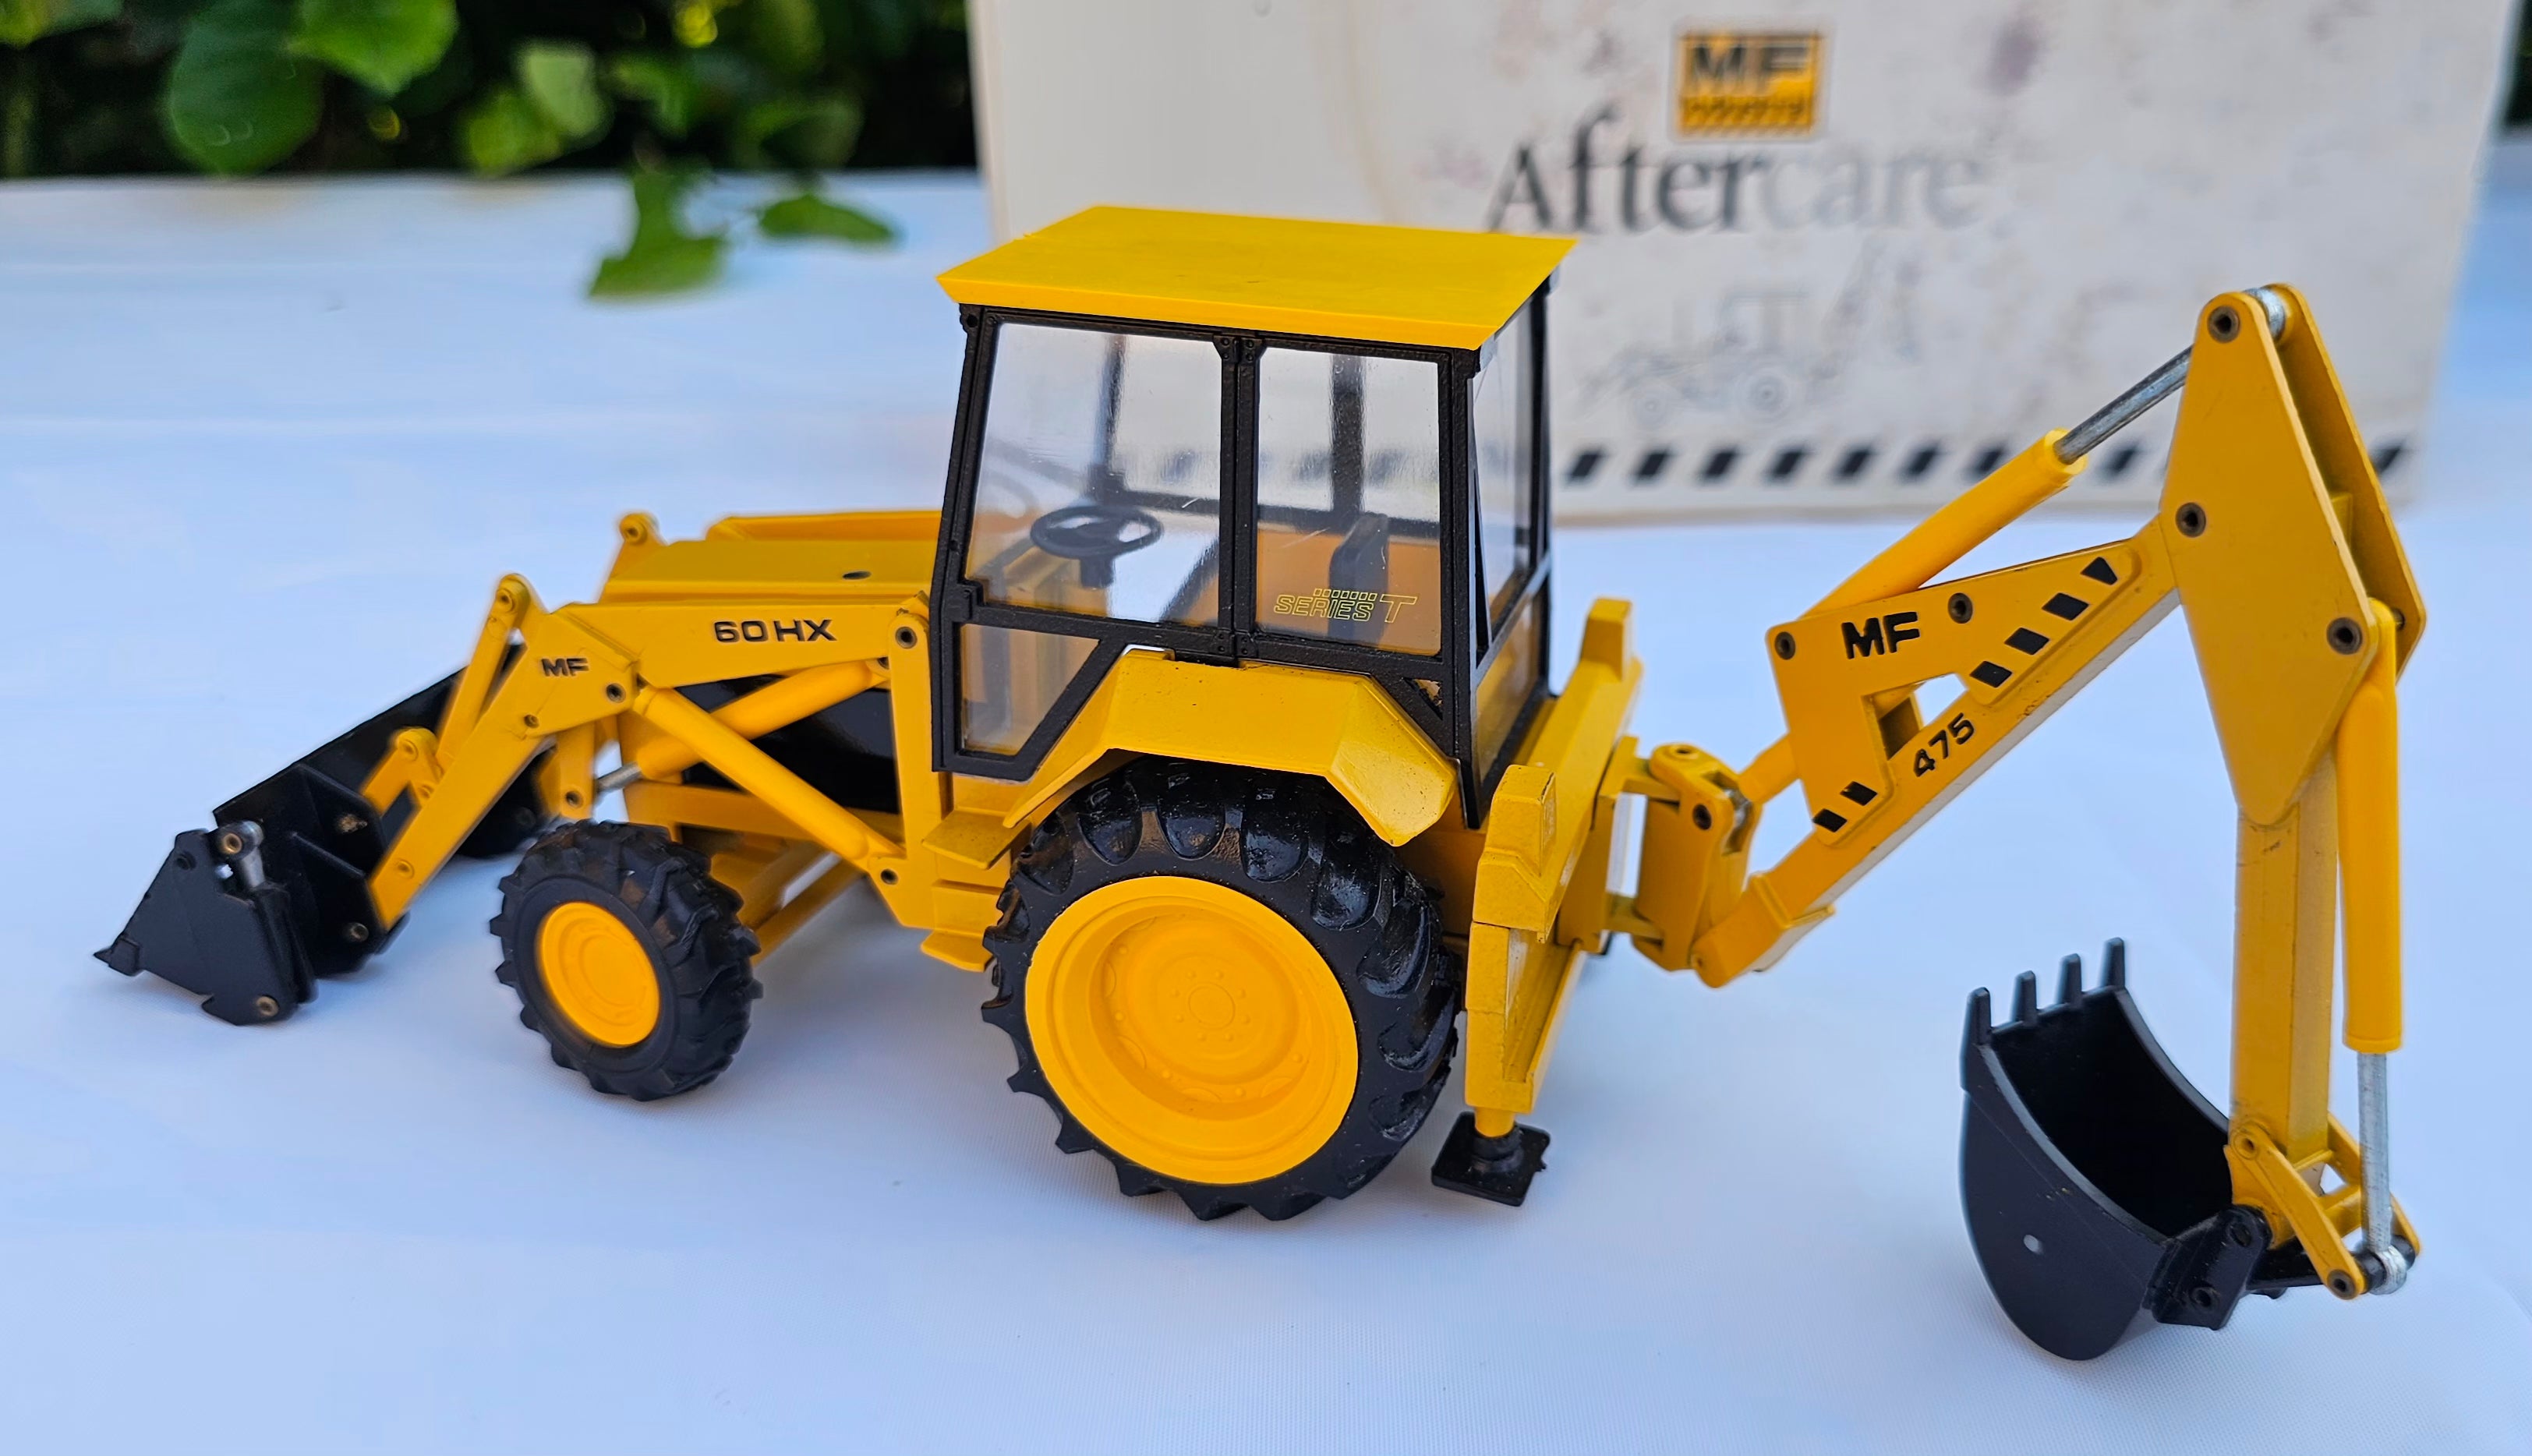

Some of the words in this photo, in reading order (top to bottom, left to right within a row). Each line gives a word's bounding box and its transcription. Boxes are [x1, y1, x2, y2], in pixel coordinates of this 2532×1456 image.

[1688, 39, 1809, 93] MF
[1485, 101, 1984, 233] Aftercare
[1273, 594, 1374, 622] SERIES
[1379, 593, 1418, 624] T
[1841, 611, 1920, 660] MF
[540, 657, 589, 677] MF
[1912, 712, 1975, 778] 475
